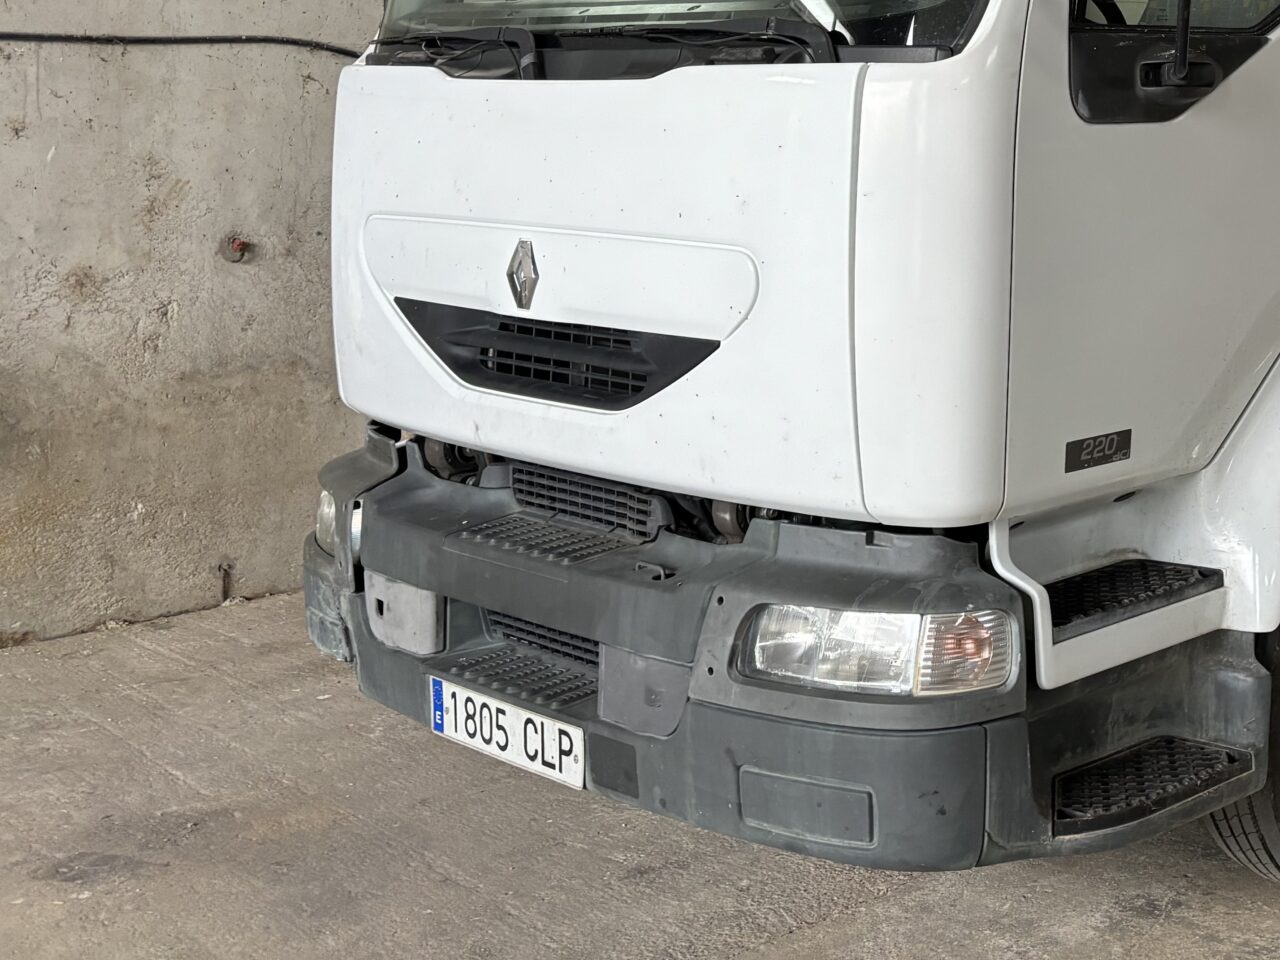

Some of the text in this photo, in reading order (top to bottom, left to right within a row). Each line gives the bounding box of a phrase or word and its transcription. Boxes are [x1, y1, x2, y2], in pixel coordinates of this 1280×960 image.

[1080, 434, 1118, 460] 220
[436, 711, 442, 724] E
[451, 691, 573, 773] 1805 CLP
